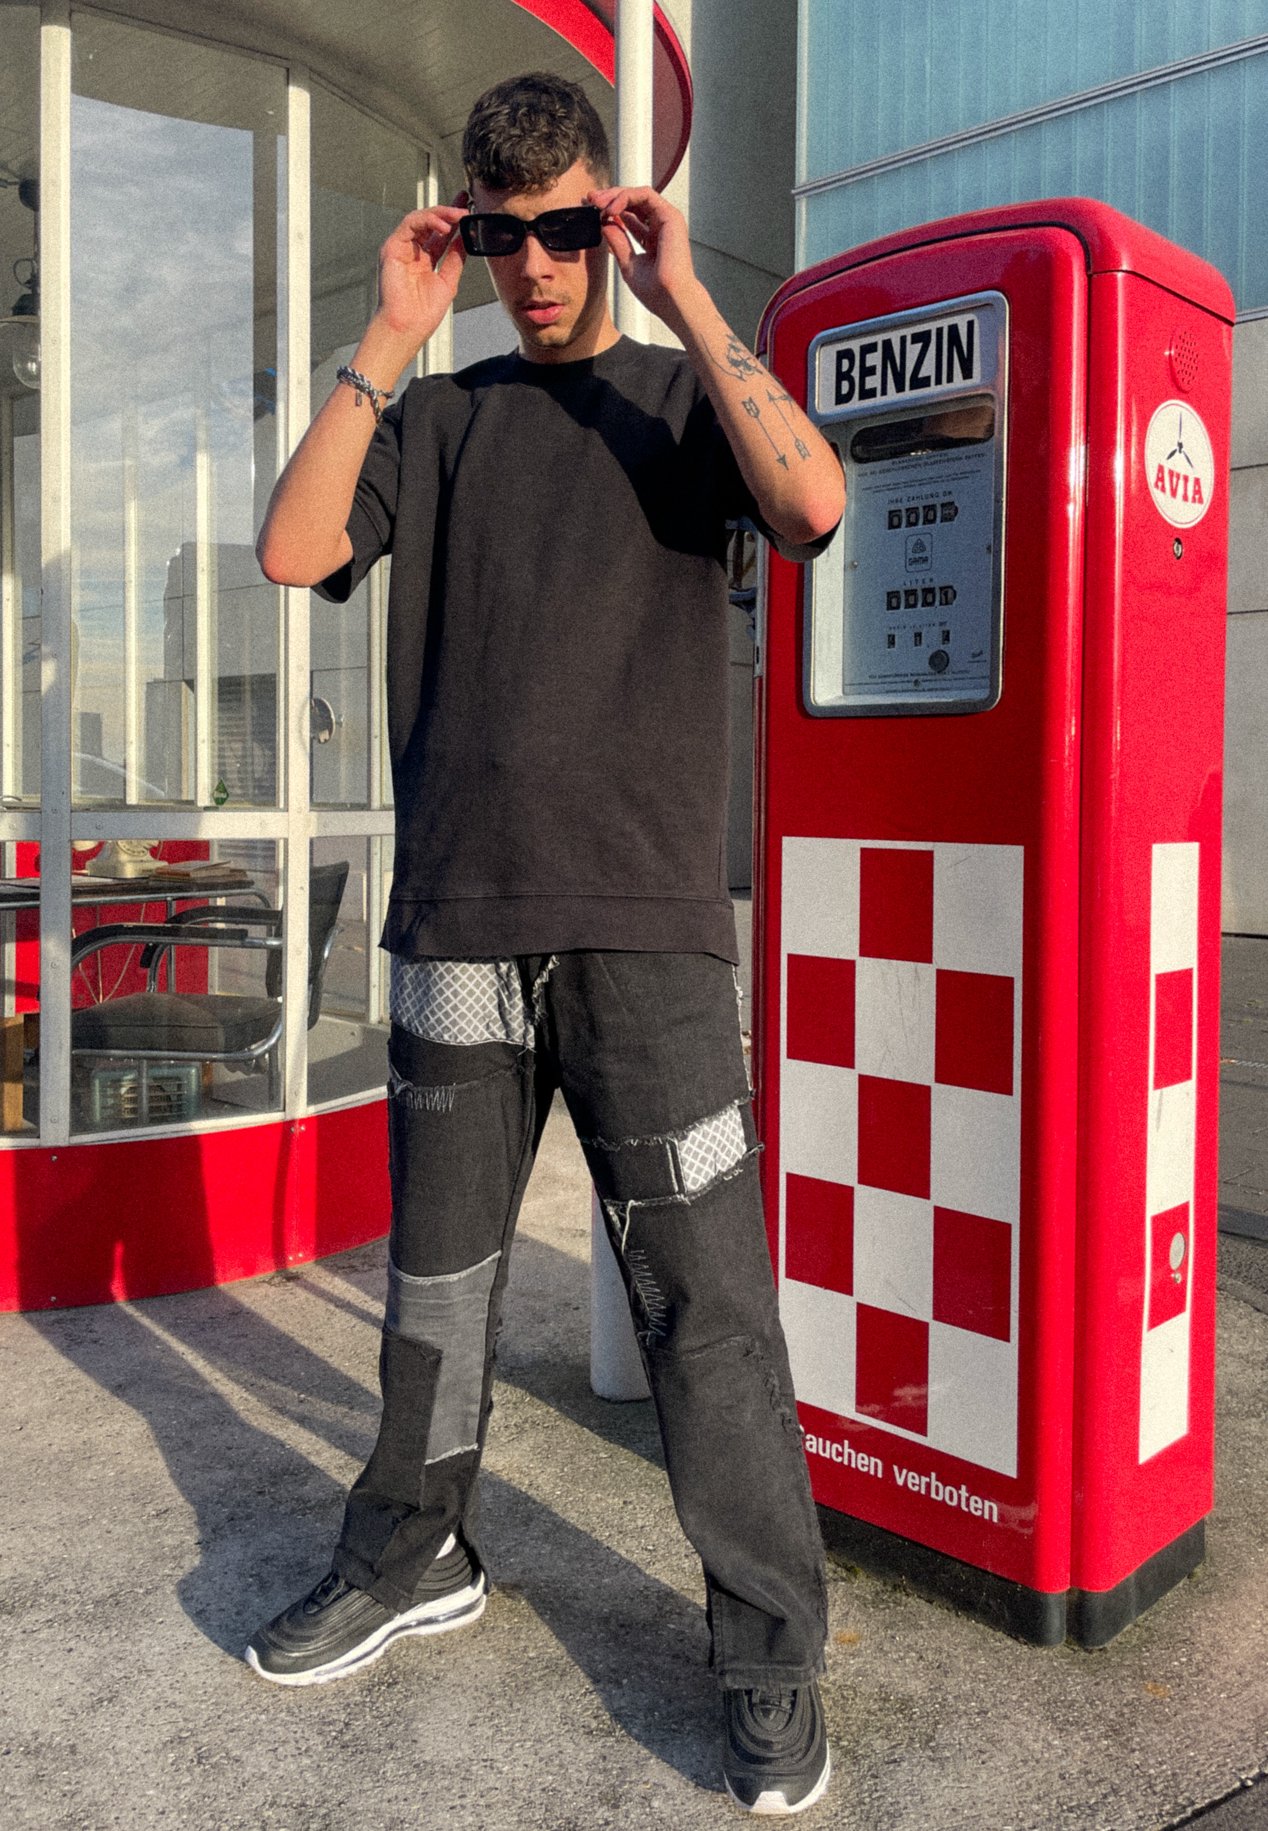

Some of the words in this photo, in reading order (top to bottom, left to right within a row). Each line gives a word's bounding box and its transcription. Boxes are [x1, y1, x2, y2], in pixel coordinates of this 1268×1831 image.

[835, 319, 975, 406] BENZIN
[907, 492, 939, 503] ZAHLUNG
[1154, 463, 1204, 505] AVIA
[903, 578, 934, 586] LITER
[800, 1425, 883, 1478] auchen
[892, 1464, 999, 1523] verboten
